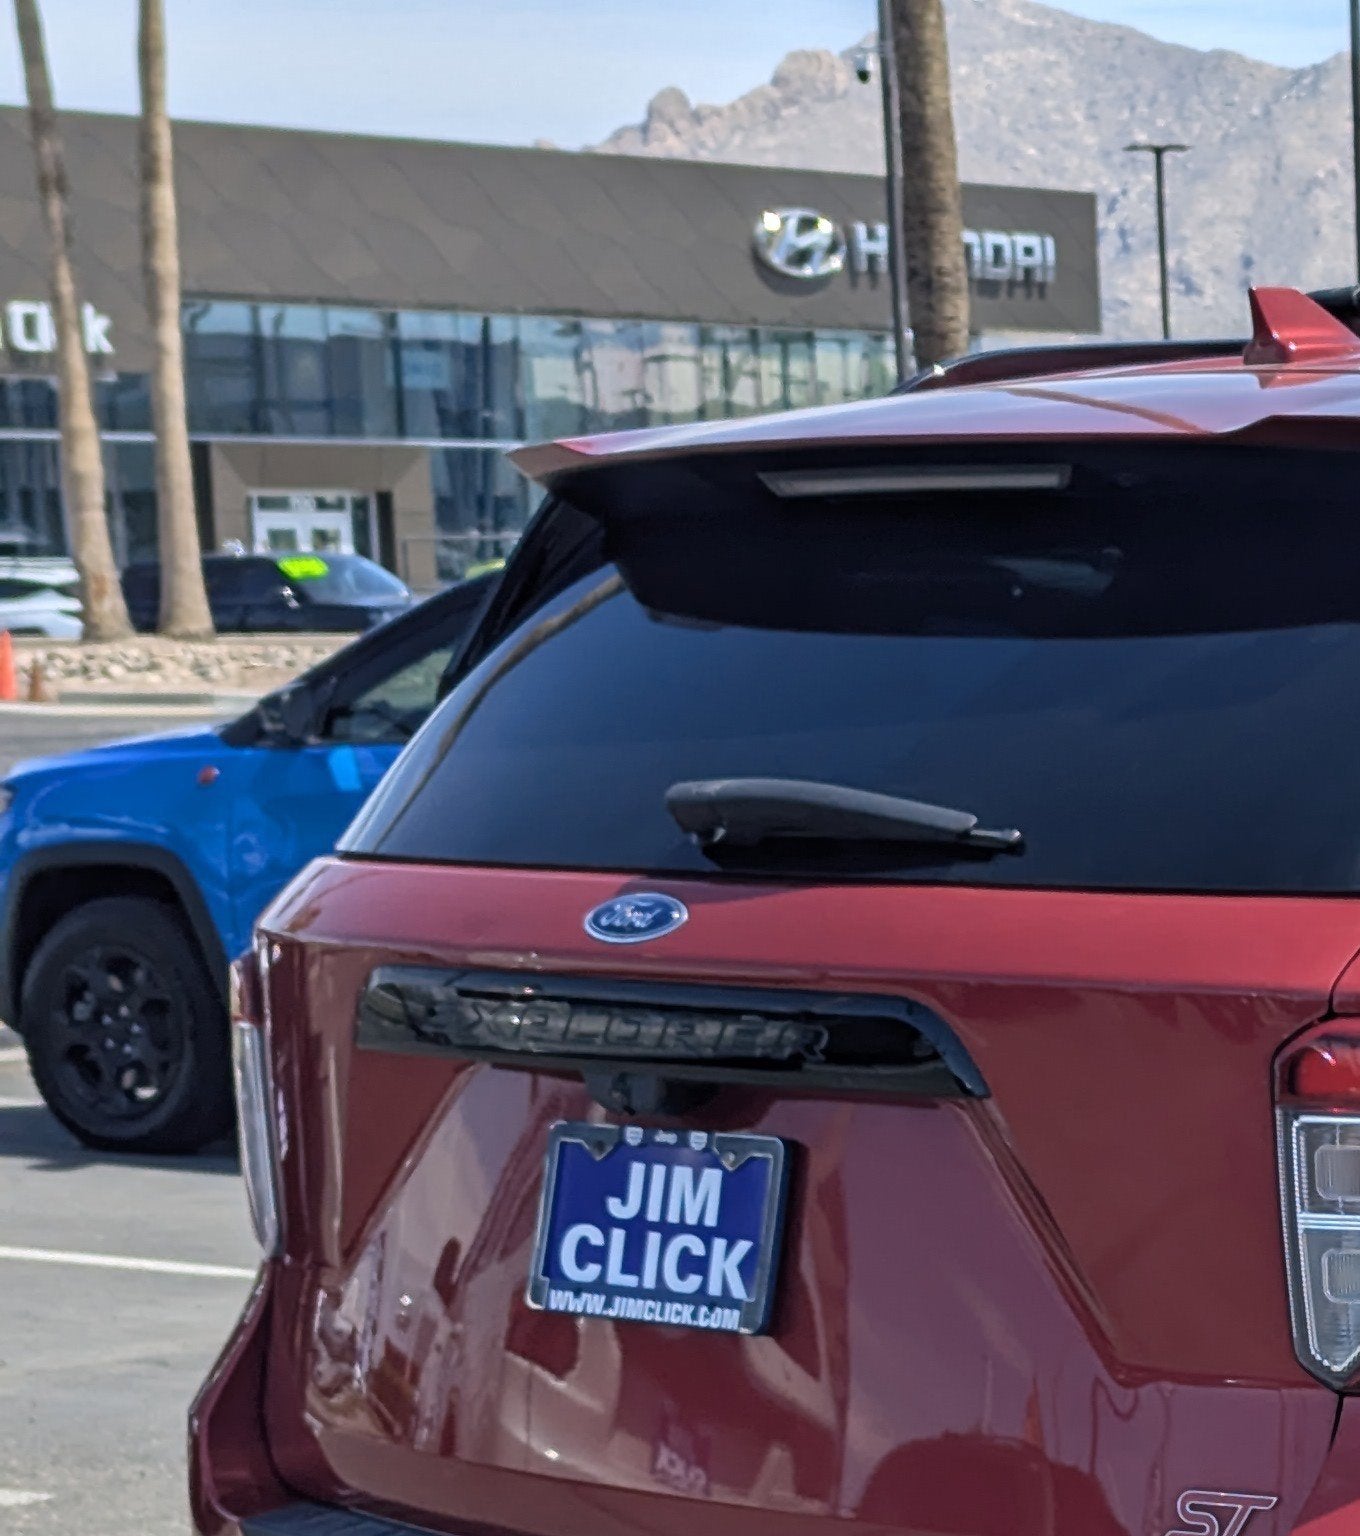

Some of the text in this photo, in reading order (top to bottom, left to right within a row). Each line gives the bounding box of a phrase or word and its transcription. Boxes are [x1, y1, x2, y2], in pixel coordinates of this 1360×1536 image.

[606, 1161, 724, 1228] JIM
[560, 1222, 754, 1301] CLICK
[548, 1287, 742, 1331] WWW.JIMCLICK.COM
